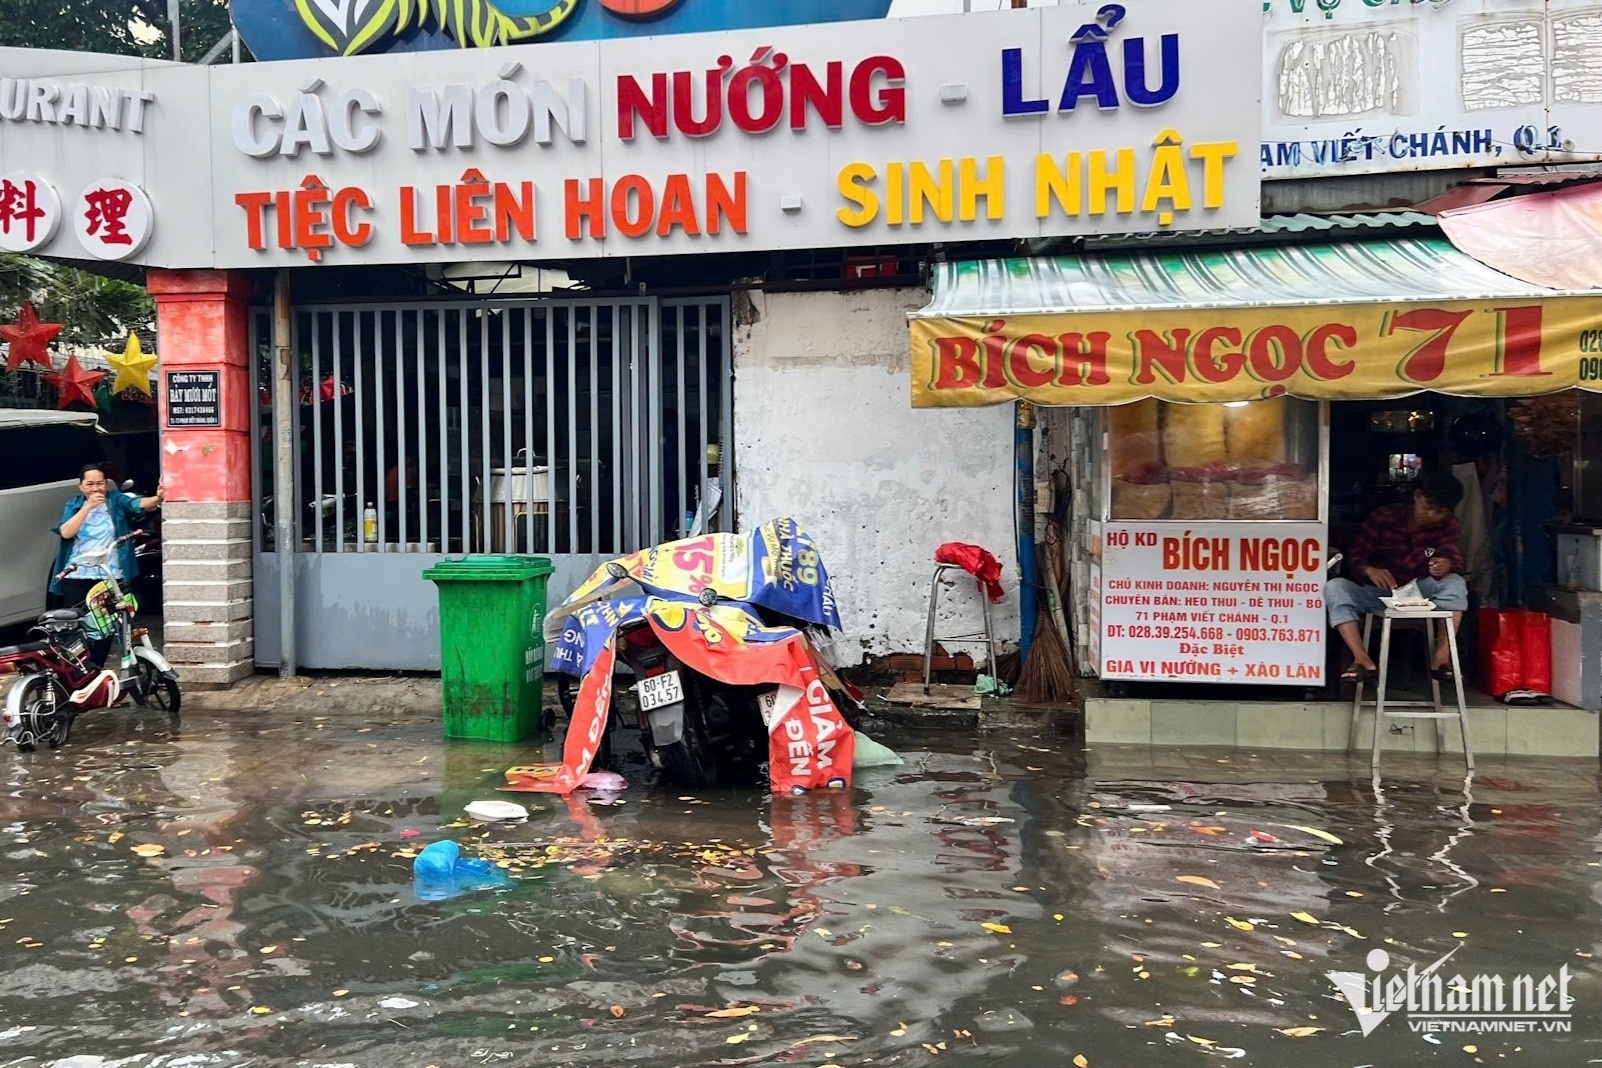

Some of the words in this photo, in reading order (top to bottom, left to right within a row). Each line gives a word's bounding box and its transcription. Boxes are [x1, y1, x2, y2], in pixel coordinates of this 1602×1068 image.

[231, 77, 383, 160] CÁC
[409, 60, 587, 153] MÓN
[616, 45, 907, 141] NƯỚNG
[1001, 4, 1180, 118] LẨU
[235, 174, 375, 262] TIỆC
[400, 167, 538, 247] LIÊN
[563, 170, 748, 240] HOAN
[835, 155, 1006, 228] SINH
[1035, 128, 1239, 226] NHẬT
[928, 319, 1111, 390] BÍCH
[1128, 322, 1357, 398] NGỌC
[1379, 305, 1553, 382] 71
[1580, 357, 1602, 381] 09
[1107, 529, 1129, 549] HỘ
[1135, 532, 1157, 546] KD
[1163, 530, 1230, 571] BÍCH
[1239, 537, 1320, 579] NGỌC
[781, 544, 798, 592] THUỐC
[1109, 577, 1131, 590] CHỦ
[1135, 580, 1163, 590] KINH
[1166, 581, 1209, 591] DOANH:
[1263, 582, 1282, 594] THỊ
[1286, 582, 1319, 594] NGỌC
[1105, 594, 1150, 605] CHUYÊN
[1185, 597, 1208, 606] HEO
[1211, 597, 1237, 607] THUI
[1267, 598, 1294, 608] THUI
[1135, 611, 1148, 620] 71
[1153, 611, 1187, 623] PHẠM
[1191, 609, 1215, 622] VIẾT
[1218, 612, 1259, 623] CHÁNH
[1271, 614, 1288, 624] Q.1
[1107, 624, 1125, 638] ĐT:
[1128, 625, 1223, 640] 028.39.254.668
[1236, 627, 1320, 642] 0903.763.871
[1179, 642, 1208, 657] Đặc
[1213, 643, 1245, 658] Biệt
[1106, 659, 1134, 673] GIA
[1139, 660, 1155, 677] VỊ
[1161, 659, 1221, 676] NƯỚNG
[1245, 661, 1280, 677] XÀO
[806, 679, 843, 770] GIẢM
[785, 718, 814, 776] ĐẾN
